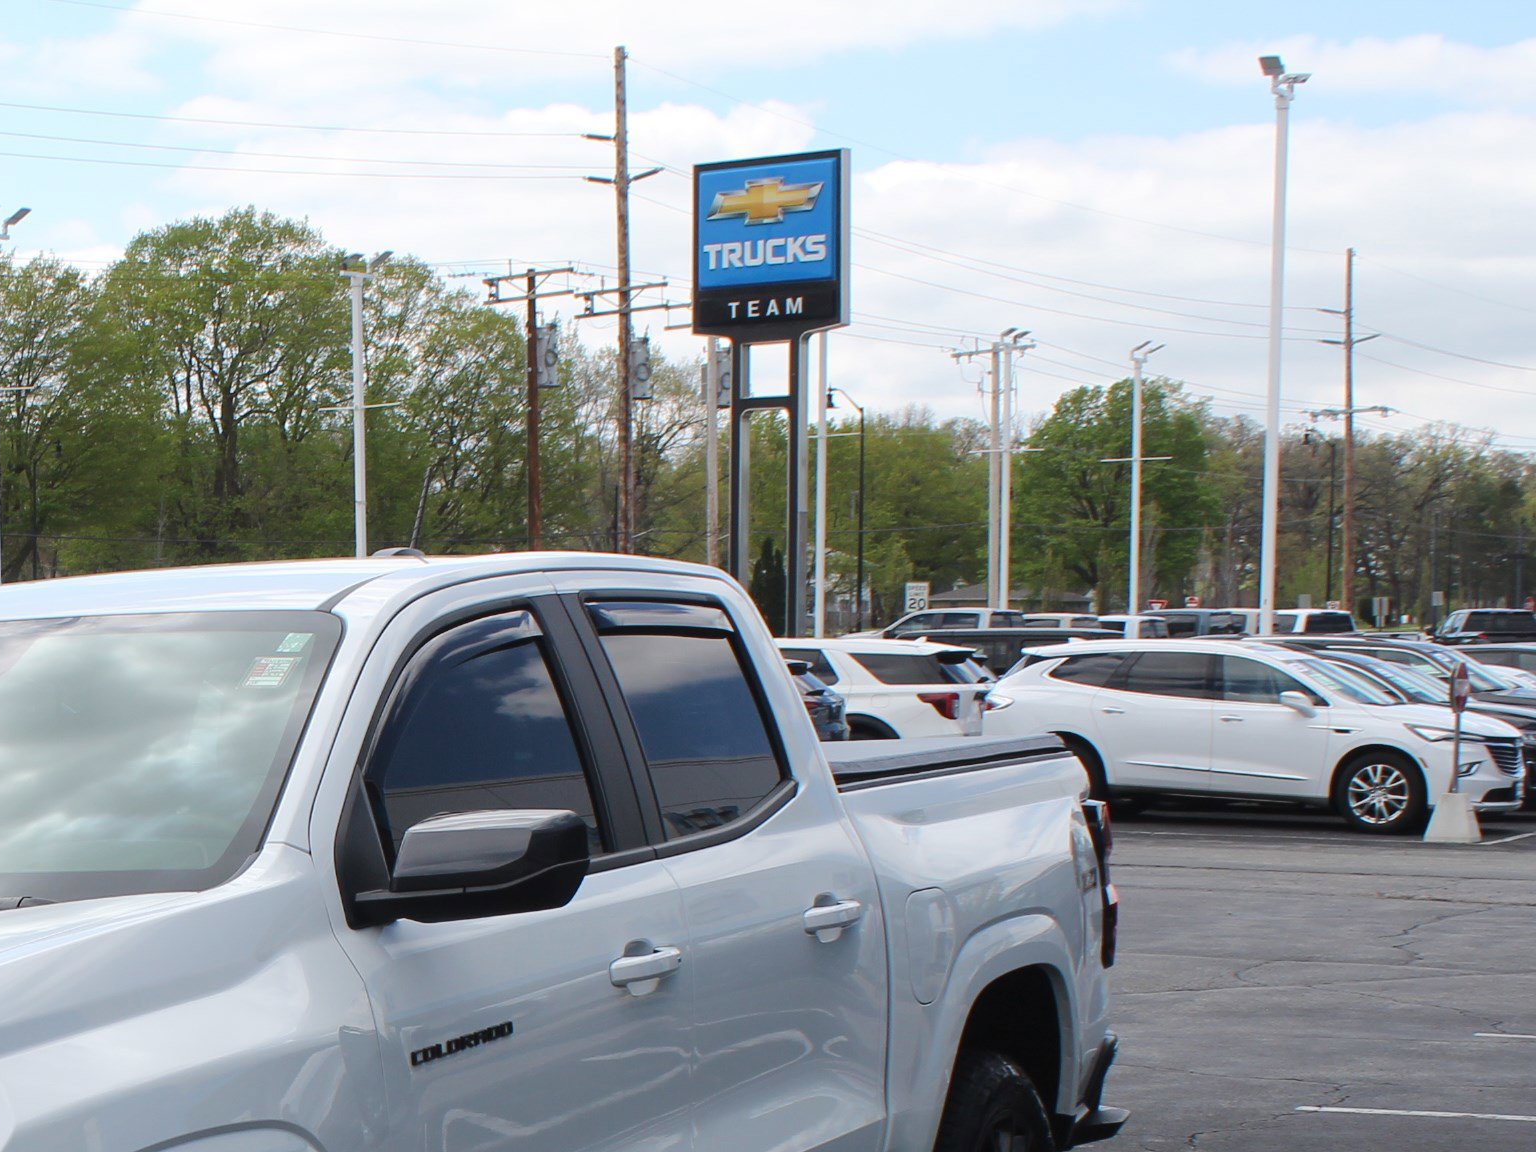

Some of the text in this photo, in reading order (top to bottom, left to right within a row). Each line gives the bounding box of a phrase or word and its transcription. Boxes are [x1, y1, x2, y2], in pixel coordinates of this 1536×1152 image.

[703, 233, 827, 270] TRUCKS
[727, 296, 804, 319] TEAM
[908, 598, 927, 610] 20
[410, 1021, 514, 1066] COLORADO
